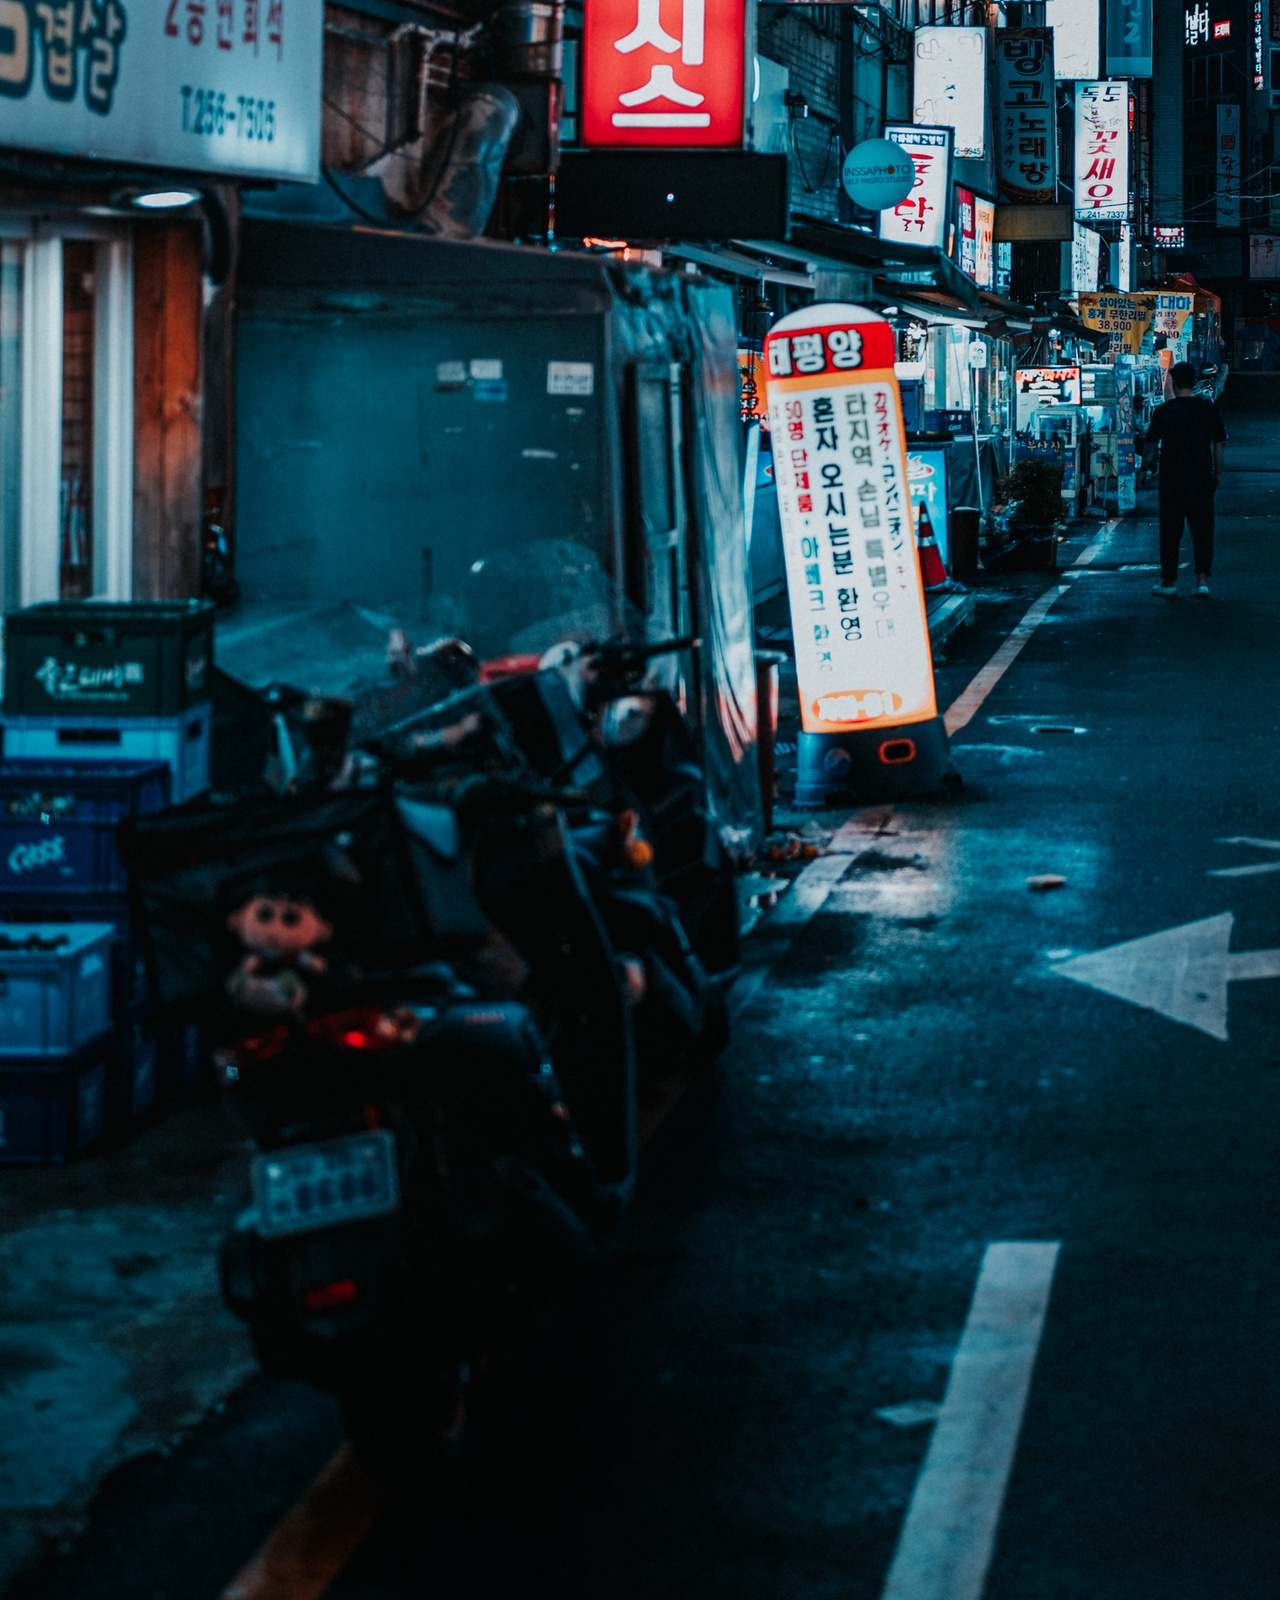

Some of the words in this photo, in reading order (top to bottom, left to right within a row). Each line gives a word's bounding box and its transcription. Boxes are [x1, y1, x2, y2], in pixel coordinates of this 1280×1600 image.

[1003, 39, 1049, 110] 빙고
[1081, 86, 1123, 103] 독도
[954, 146, 982, 156] 2-9945
[1004, 115, 1016, 170] カラオケ
[1017, 111, 1051, 185] 노래방
[1082, 130, 1119, 209] 꽃새우
[1087, 210, 1126, 219] 241-7337
[1087, 308, 1106, 319] 홍게
[1109, 309, 1147, 322] 무한리필
[1098, 297, 1137, 309] 살아있는
[1098, 320, 1132, 332] 38,900
[844, 392, 874, 467] 타지역
[812, 397, 838, 451] 혼자
[837, 586, 863, 642] 환영
[856, 479, 881, 529] 손님
